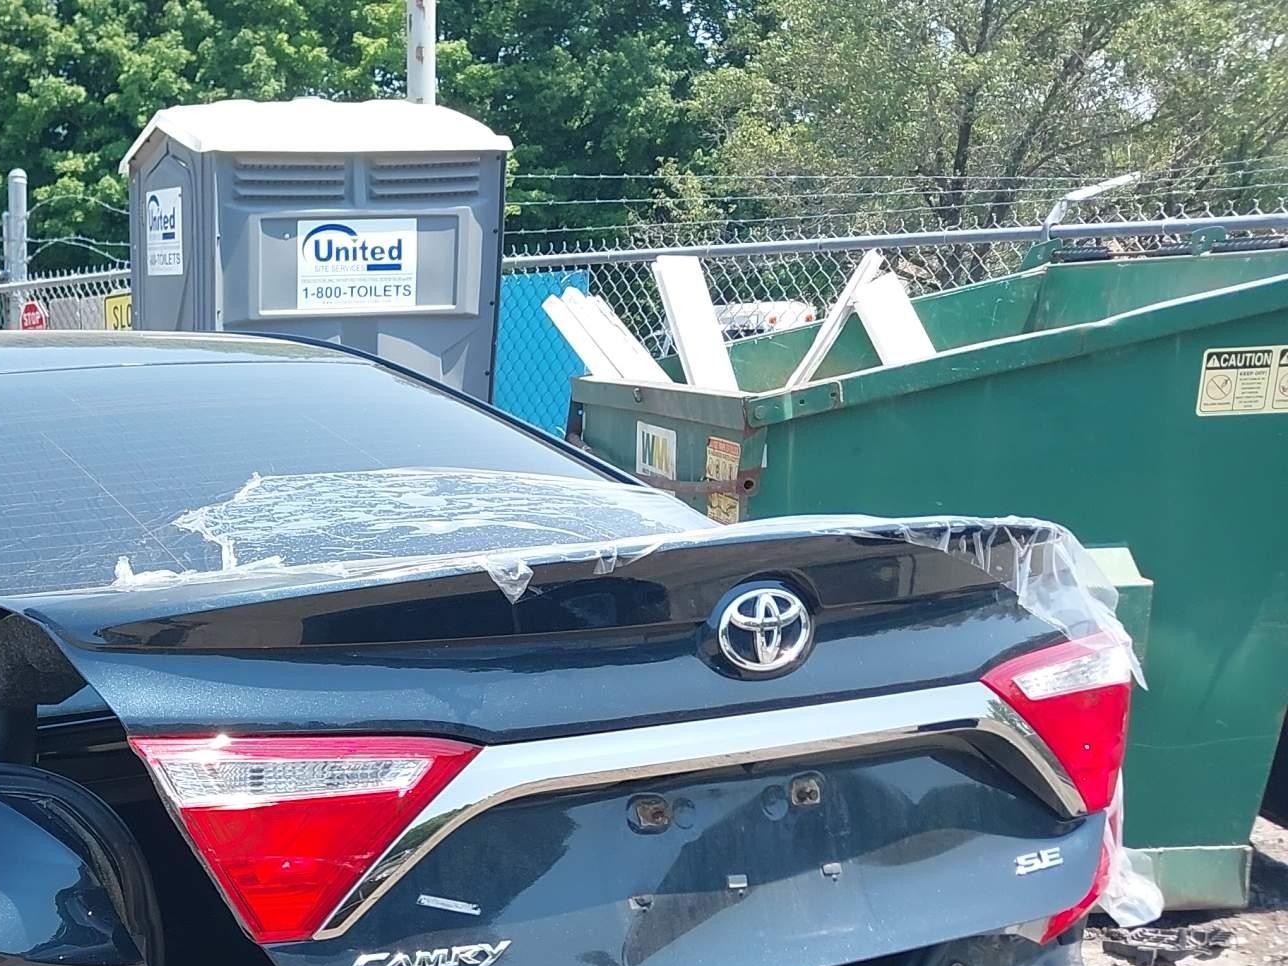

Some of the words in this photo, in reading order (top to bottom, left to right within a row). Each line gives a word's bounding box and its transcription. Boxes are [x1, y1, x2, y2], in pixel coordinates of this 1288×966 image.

[314, 238, 402, 262] United
[314, 264, 329, 273] SITE
[332, 263, 365, 273] SERVICES
[302, 284, 412, 299] 1-800-TOILETS
[23, 311, 41, 326] STOP
[1220, 351, 1272, 367] CAUTION
[641, 430, 670, 474] WM
[1016, 847, 1063, 875] SE
